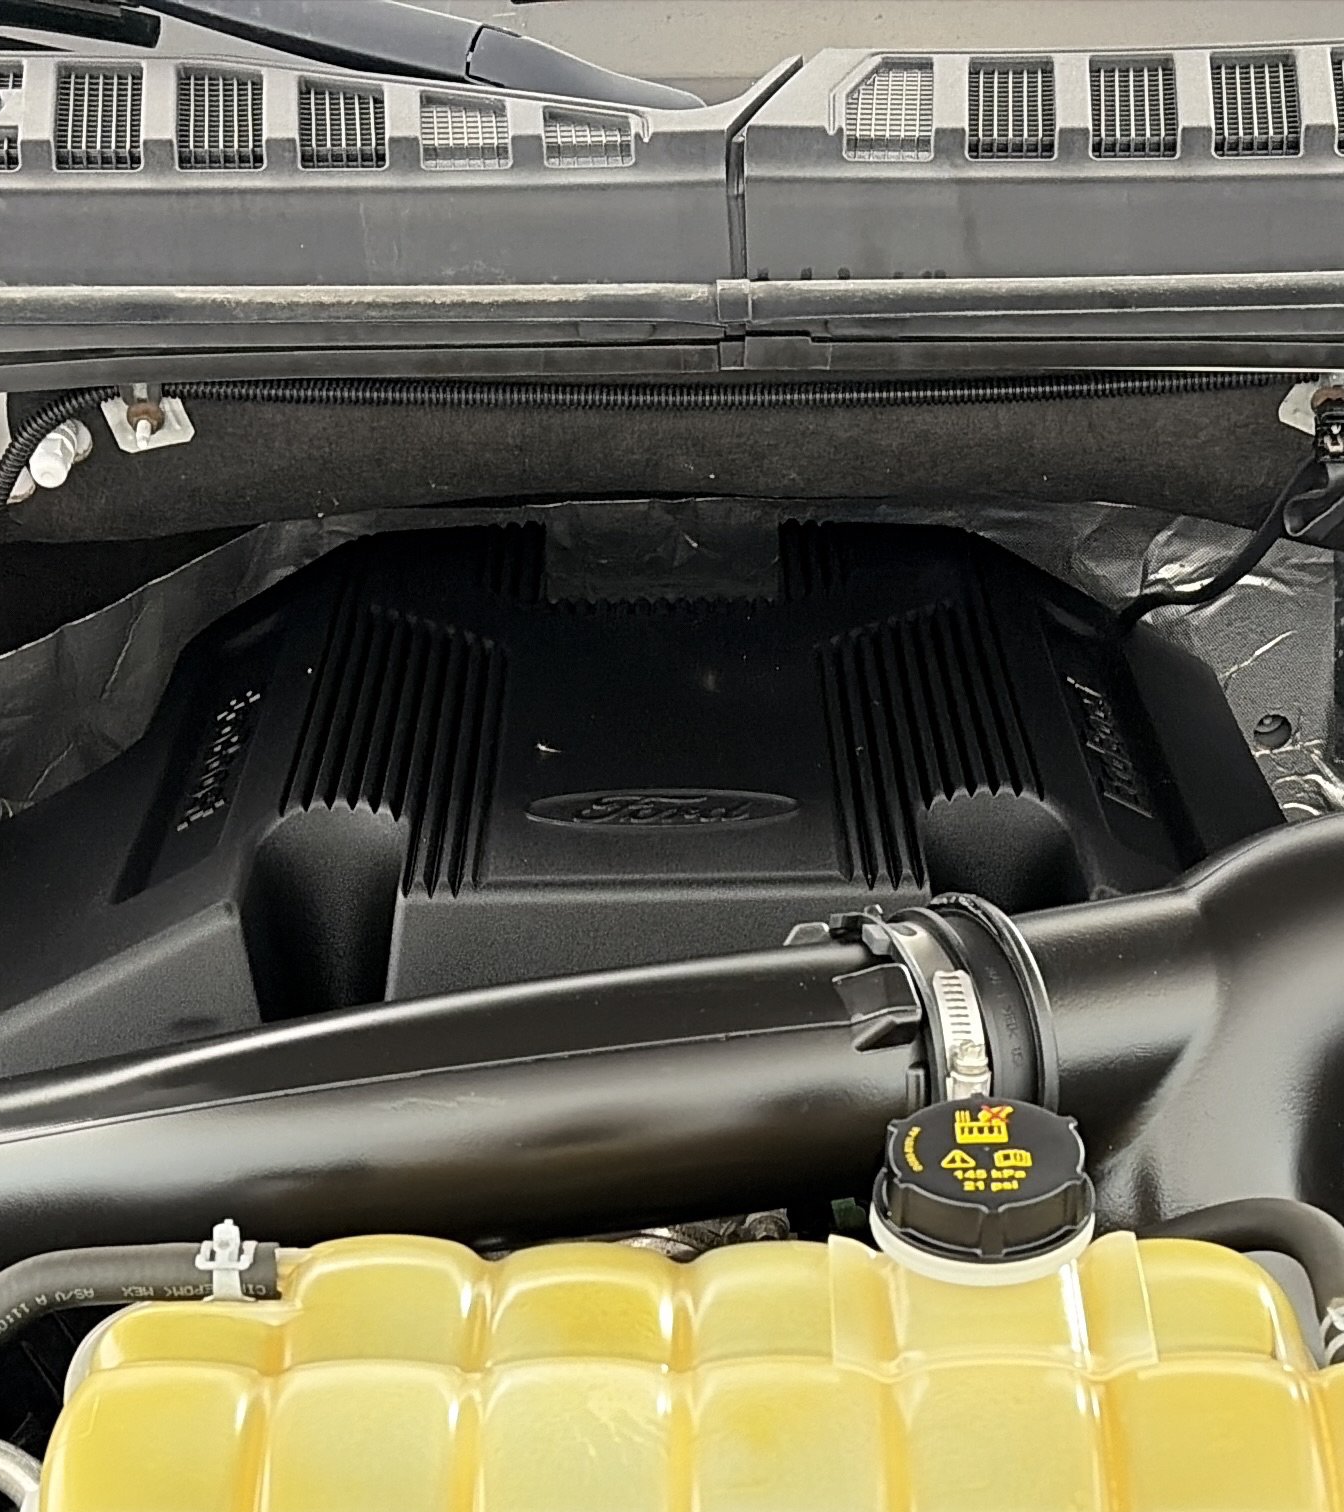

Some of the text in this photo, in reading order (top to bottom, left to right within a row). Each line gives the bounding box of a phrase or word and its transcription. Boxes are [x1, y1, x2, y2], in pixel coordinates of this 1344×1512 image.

[572, 793, 753, 824] Ford
[963, 1179, 1019, 1192] 21 psi
[121, 1284, 155, 1297] MEX
